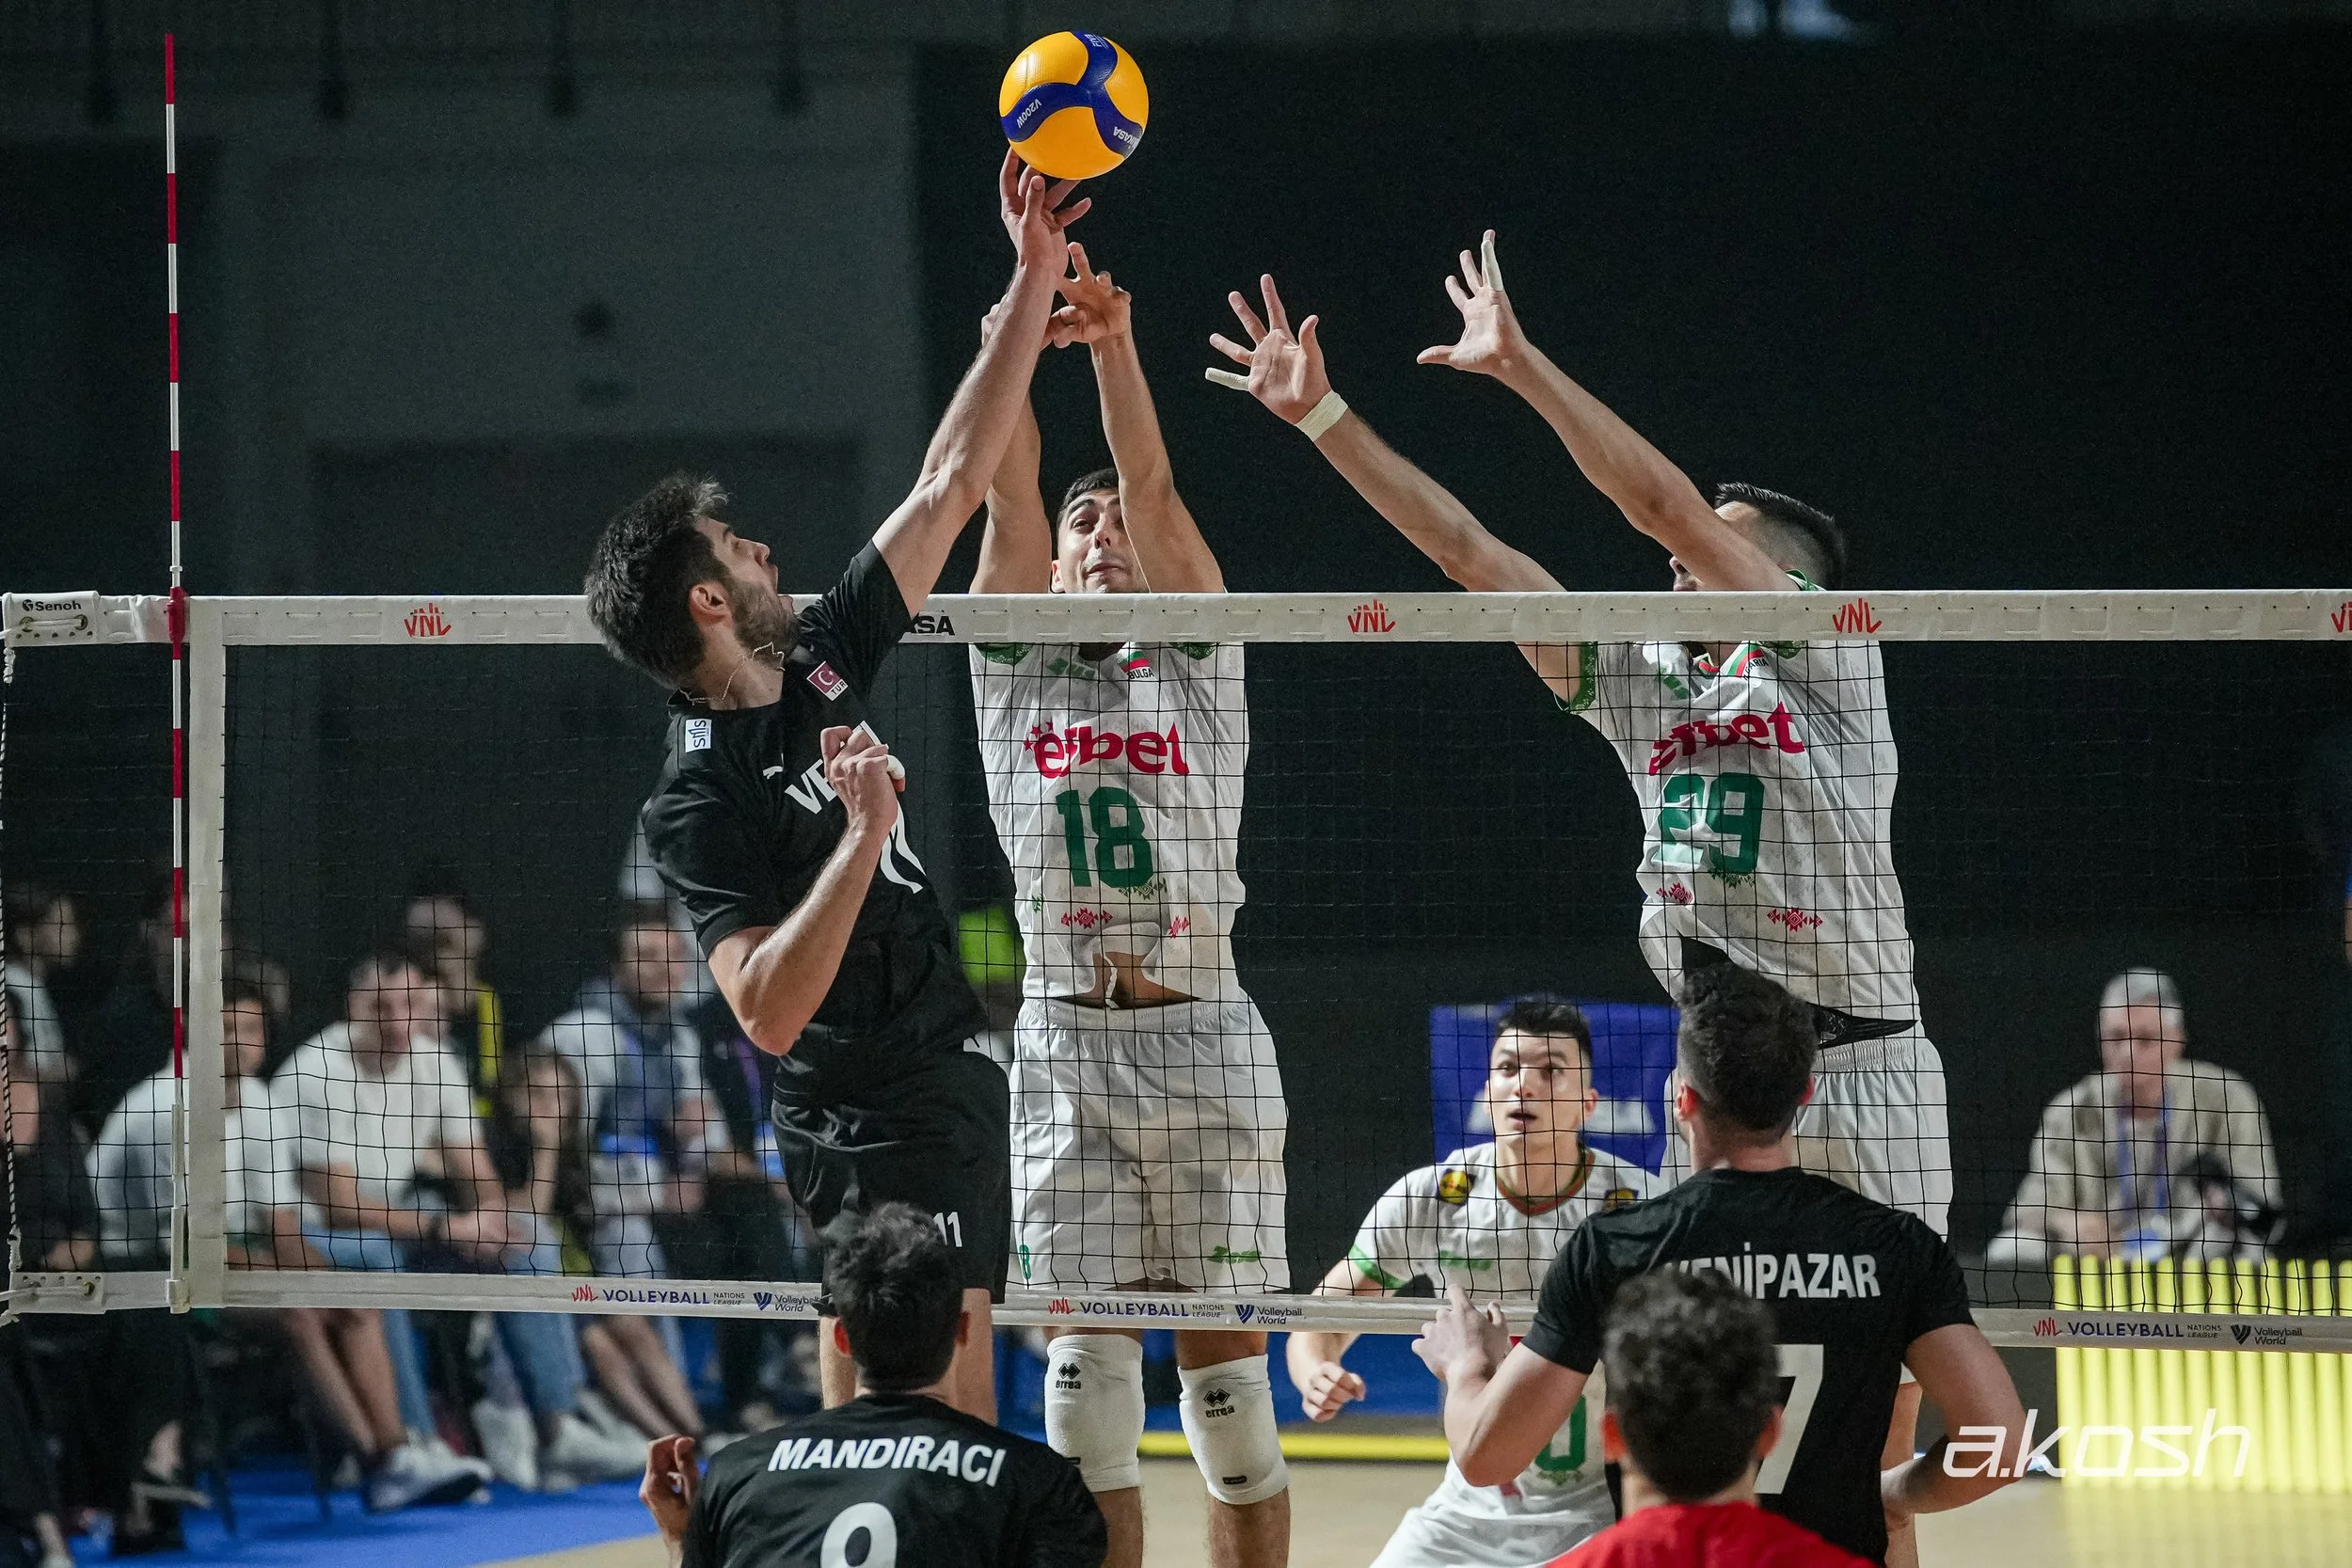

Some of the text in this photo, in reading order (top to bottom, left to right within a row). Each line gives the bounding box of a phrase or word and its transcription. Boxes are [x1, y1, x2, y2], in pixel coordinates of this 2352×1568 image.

[1016, 98, 1042, 128] V200W
[35, 600, 82, 611] Senoh
[1347, 597, 1396, 633] VNL
[1832, 597, 1883, 633] VNL
[404, 602, 452, 637] VNL
[831, 680, 846, 695] TUR
[1651, 772, 1764, 873] 29
[1056, 786, 1154, 888] 18
[572, 1284, 710, 1304] VNL VOLLEYBALL
[774, 1303, 804, 1312] World
[1047, 1297, 1189, 1317] VNL VOLLEYBALL
[1257, 1307, 1303, 1318] Volleyball
[1256, 1316, 1287, 1325] World
[2033, 1317, 2185, 1338] VNL VOLLEYBALL
[2254, 1326, 2303, 1338] Volleyball
[2254, 1336, 2287, 1346] World
[767, 1435, 1008, 1487] MANDIRACI
